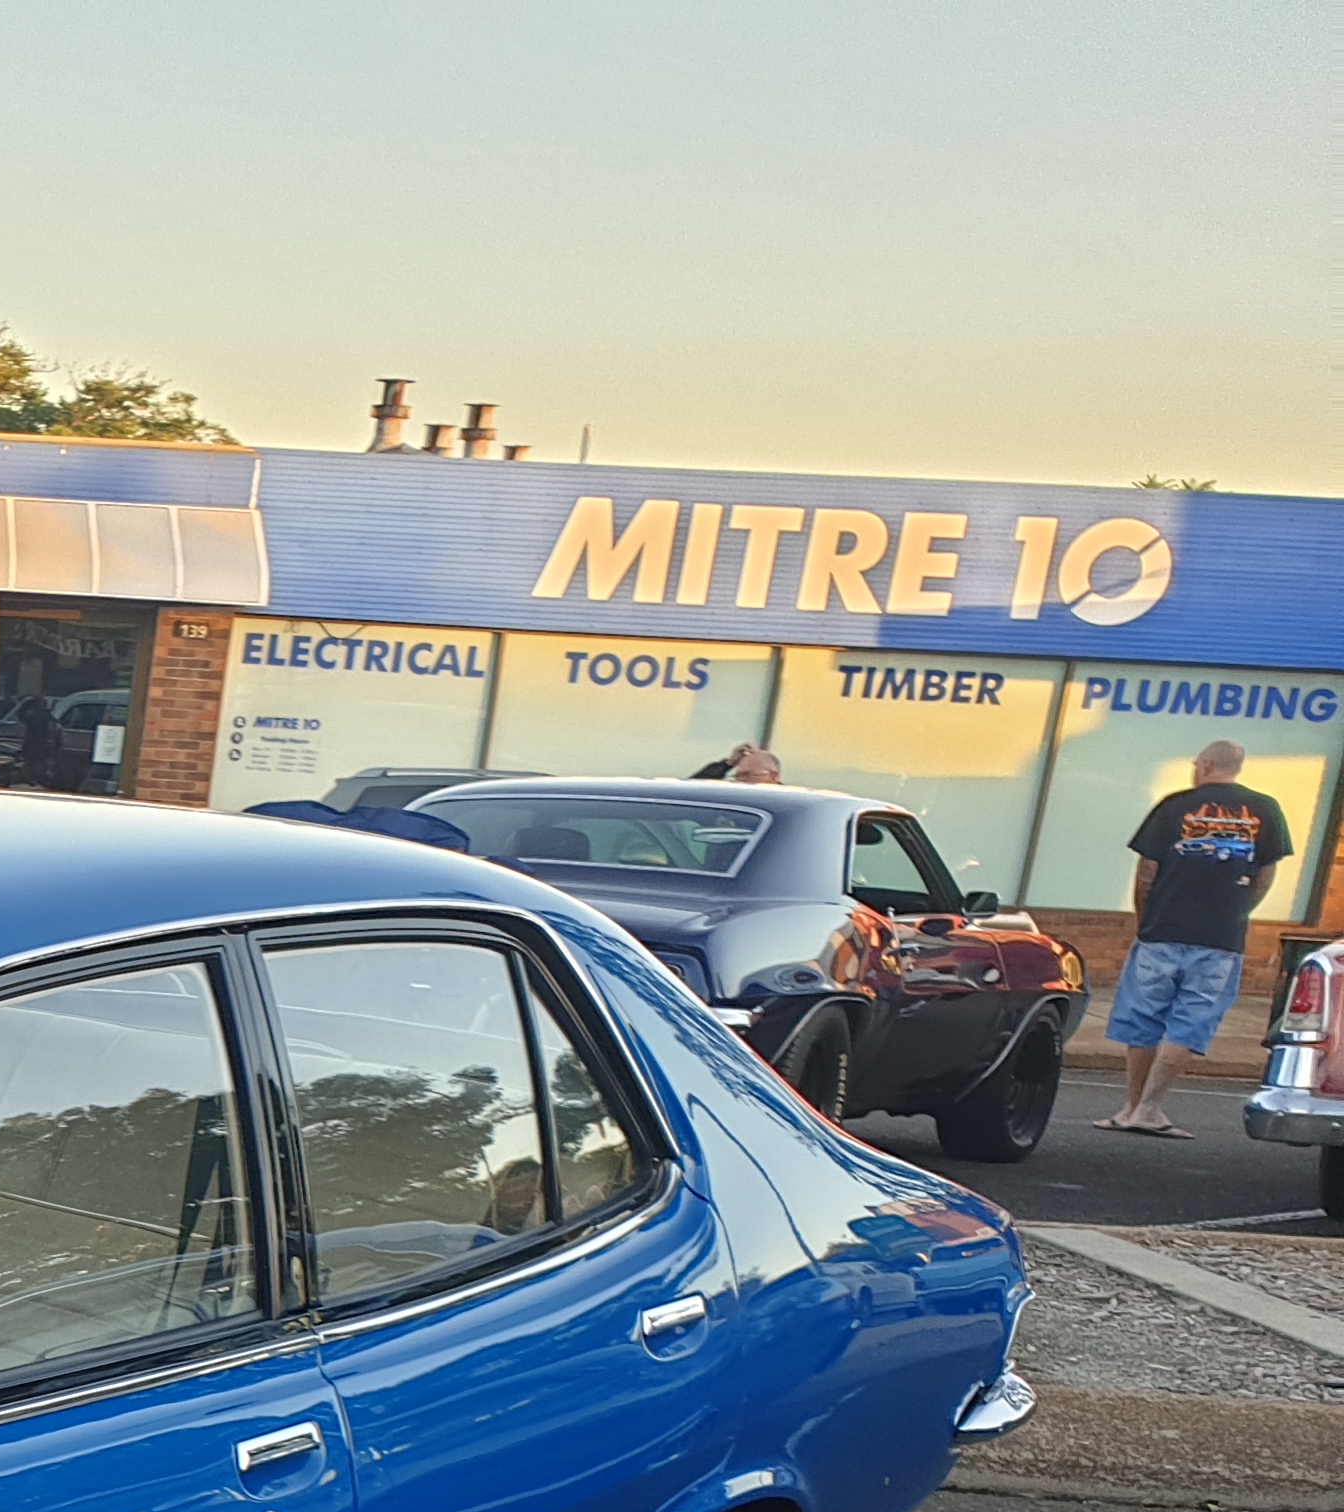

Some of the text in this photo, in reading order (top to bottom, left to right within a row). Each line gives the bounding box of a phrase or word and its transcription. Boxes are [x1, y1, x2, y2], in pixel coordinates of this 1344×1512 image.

[531, 496, 1172, 627] MITRE 10
[179, 623, 209, 639] 139
[242, 632, 487, 678] ELECTRICAL
[563, 650, 711, 691] TOOLS
[837, 664, 1006, 706] TIMBER
[1080, 676, 1339, 723] PLUMBING
